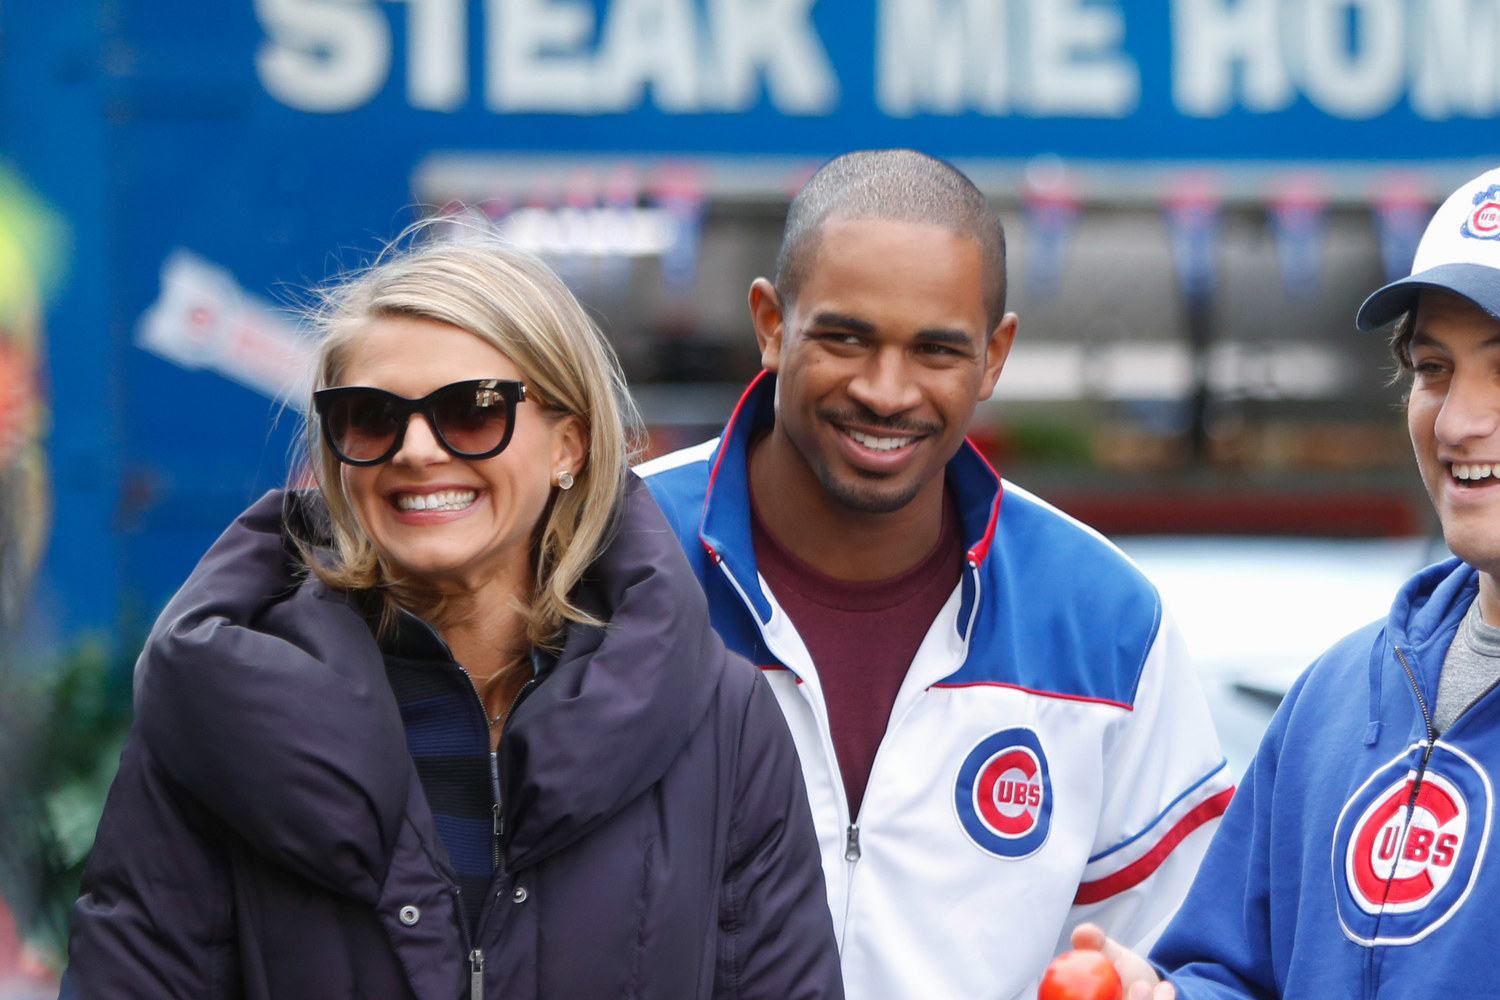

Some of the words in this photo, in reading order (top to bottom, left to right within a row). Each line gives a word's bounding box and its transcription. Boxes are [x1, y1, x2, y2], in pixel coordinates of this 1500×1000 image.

[255, 0, 838, 114] STEAK
[874, 0, 1142, 119] ME
[977, 750, 1041, 835] CUBS
[1353, 779, 1460, 905] CUBS
